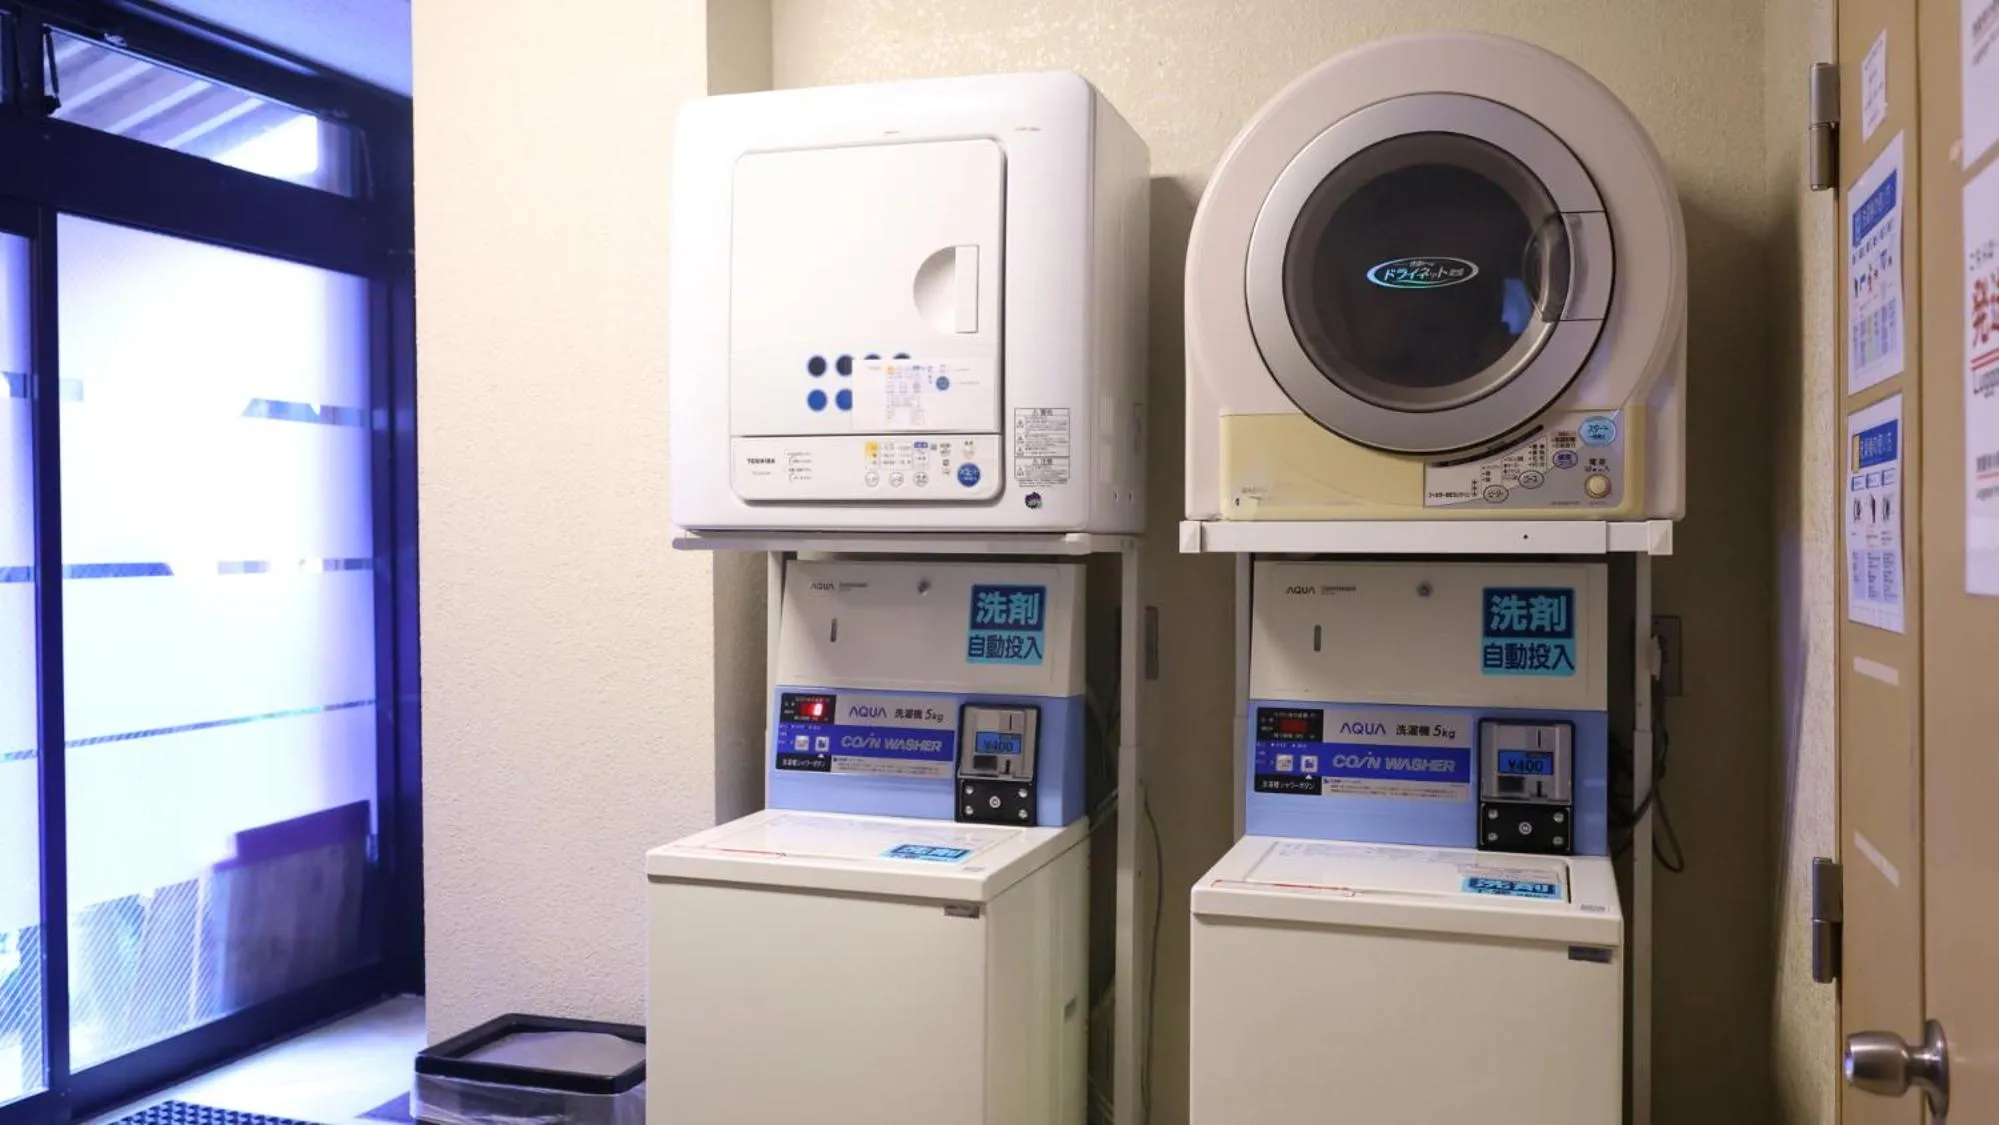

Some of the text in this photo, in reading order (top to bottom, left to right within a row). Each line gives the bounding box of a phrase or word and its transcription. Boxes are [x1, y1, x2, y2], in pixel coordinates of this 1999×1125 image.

[1286, 586, 1315, 595] AQUA
[976, 592, 1040, 625] 洗剤
[1490, 595, 1567, 632] 洗剤
[968, 634, 1042, 660] 自動投入
[1483, 643, 1574, 671] 自動投入
[849, 706, 944, 723] AQUA 洗濯機 5kg
[1340, 722, 1455, 740] AQUA 洗濯機 5kg
[884, 739, 943, 753] WASHER
[1386, 757, 1455, 773] WASHER
